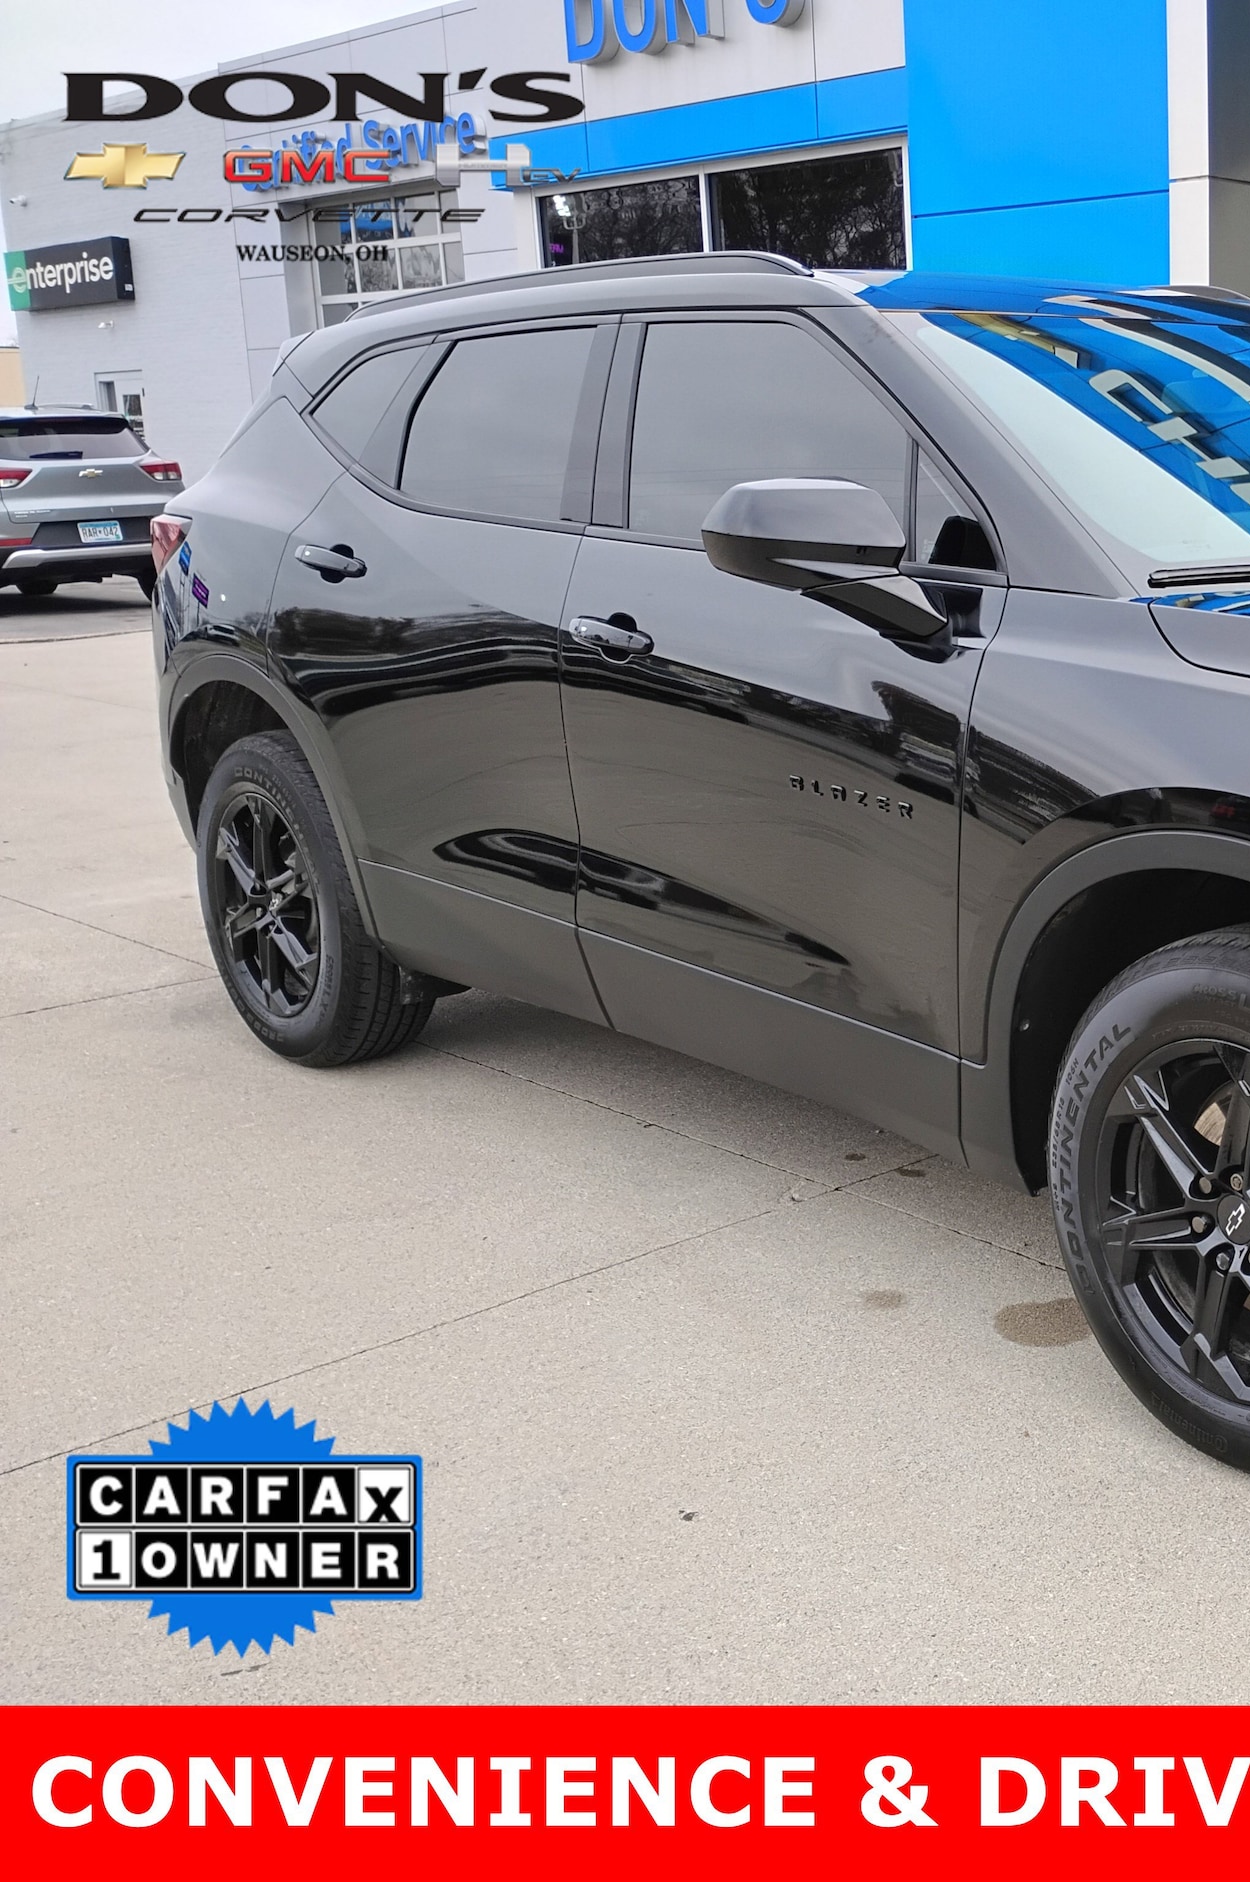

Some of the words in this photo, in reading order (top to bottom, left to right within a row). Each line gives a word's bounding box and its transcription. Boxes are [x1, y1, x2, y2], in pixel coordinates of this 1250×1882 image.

[563, 0, 789, 63] DON
[9, 251, 114, 294] enterprise
[789, 775, 913, 819] BLAZER
[1059, 1023, 1131, 1296] CONTINENTAL
